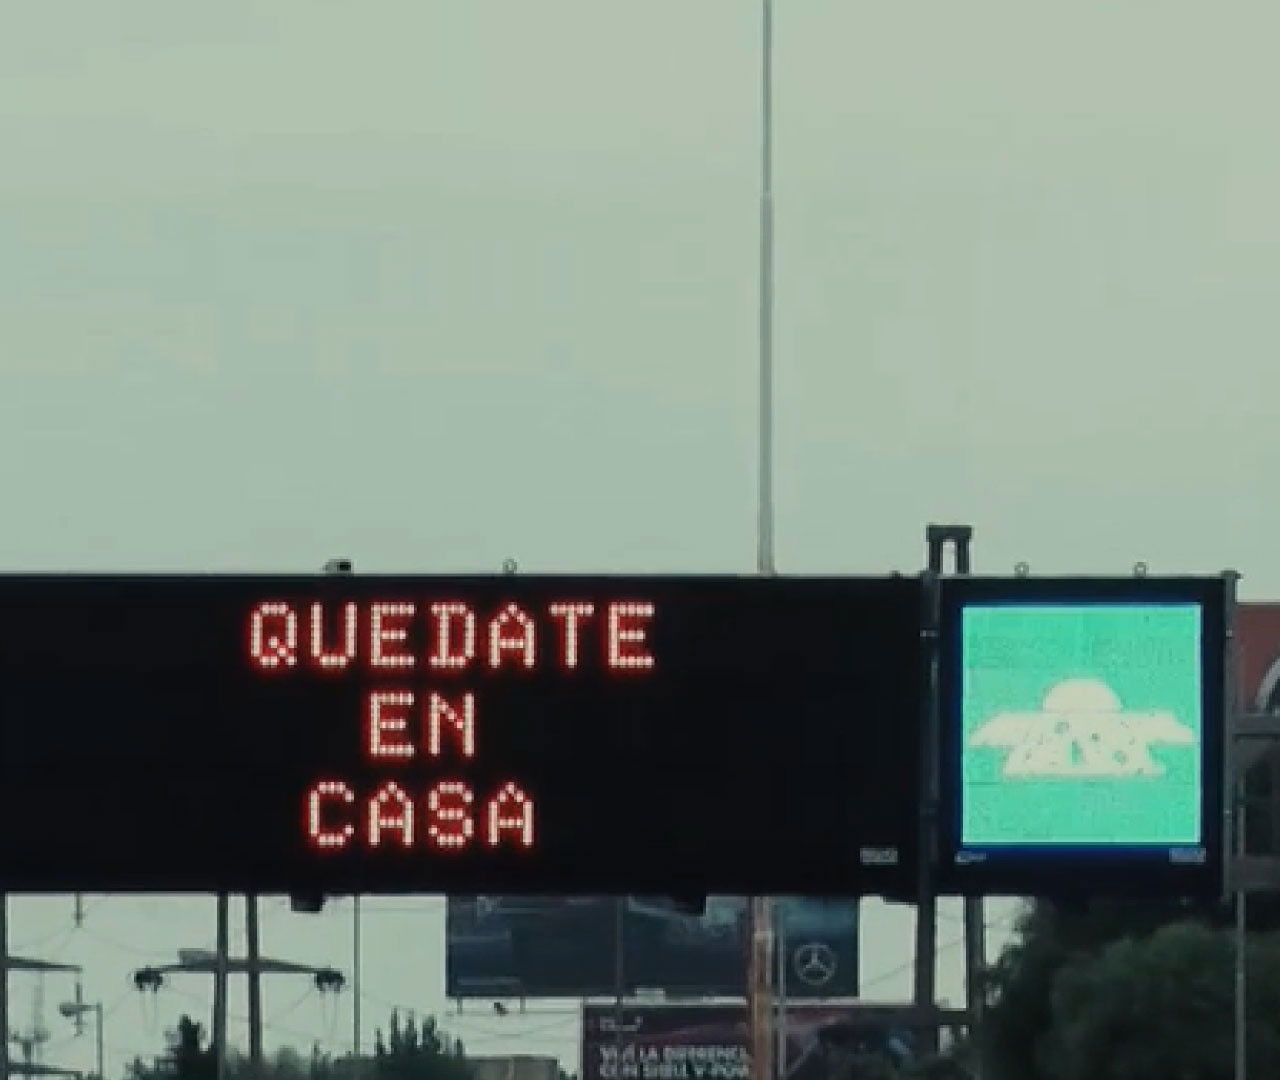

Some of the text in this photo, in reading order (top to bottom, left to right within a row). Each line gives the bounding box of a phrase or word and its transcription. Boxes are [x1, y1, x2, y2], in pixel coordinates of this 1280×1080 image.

[248, 600, 656, 670] QUEDATE
[366, 689, 476, 759] EN
[305, 780, 535, 850] CASA
